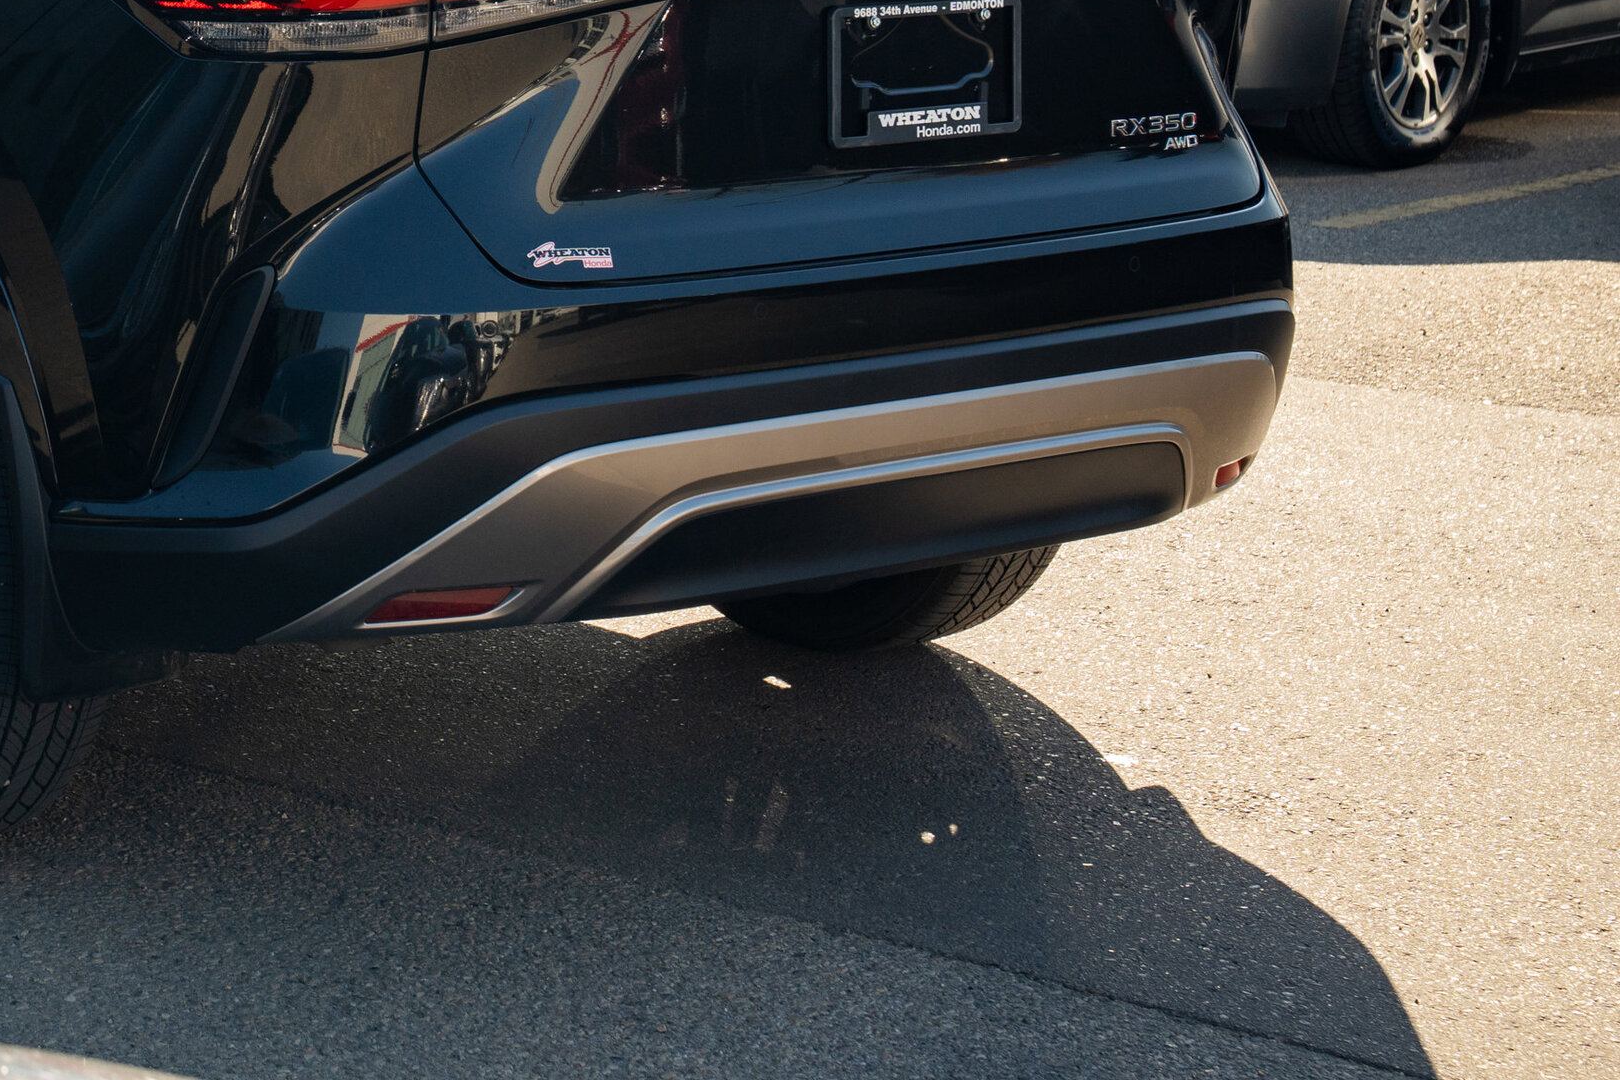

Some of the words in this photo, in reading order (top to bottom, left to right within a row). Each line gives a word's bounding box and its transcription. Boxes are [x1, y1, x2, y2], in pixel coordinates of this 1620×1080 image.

[854, 7, 878, 18] 9688
[880, 4, 902, 16] 34th
[903, 3, 938, 15] Avenue
[878, 106, 980, 127] WHEATON
[916, 123, 980, 138] Honda.com
[1163, 134, 1199, 151] AWD
[533, 248, 610, 258] WHEATON
